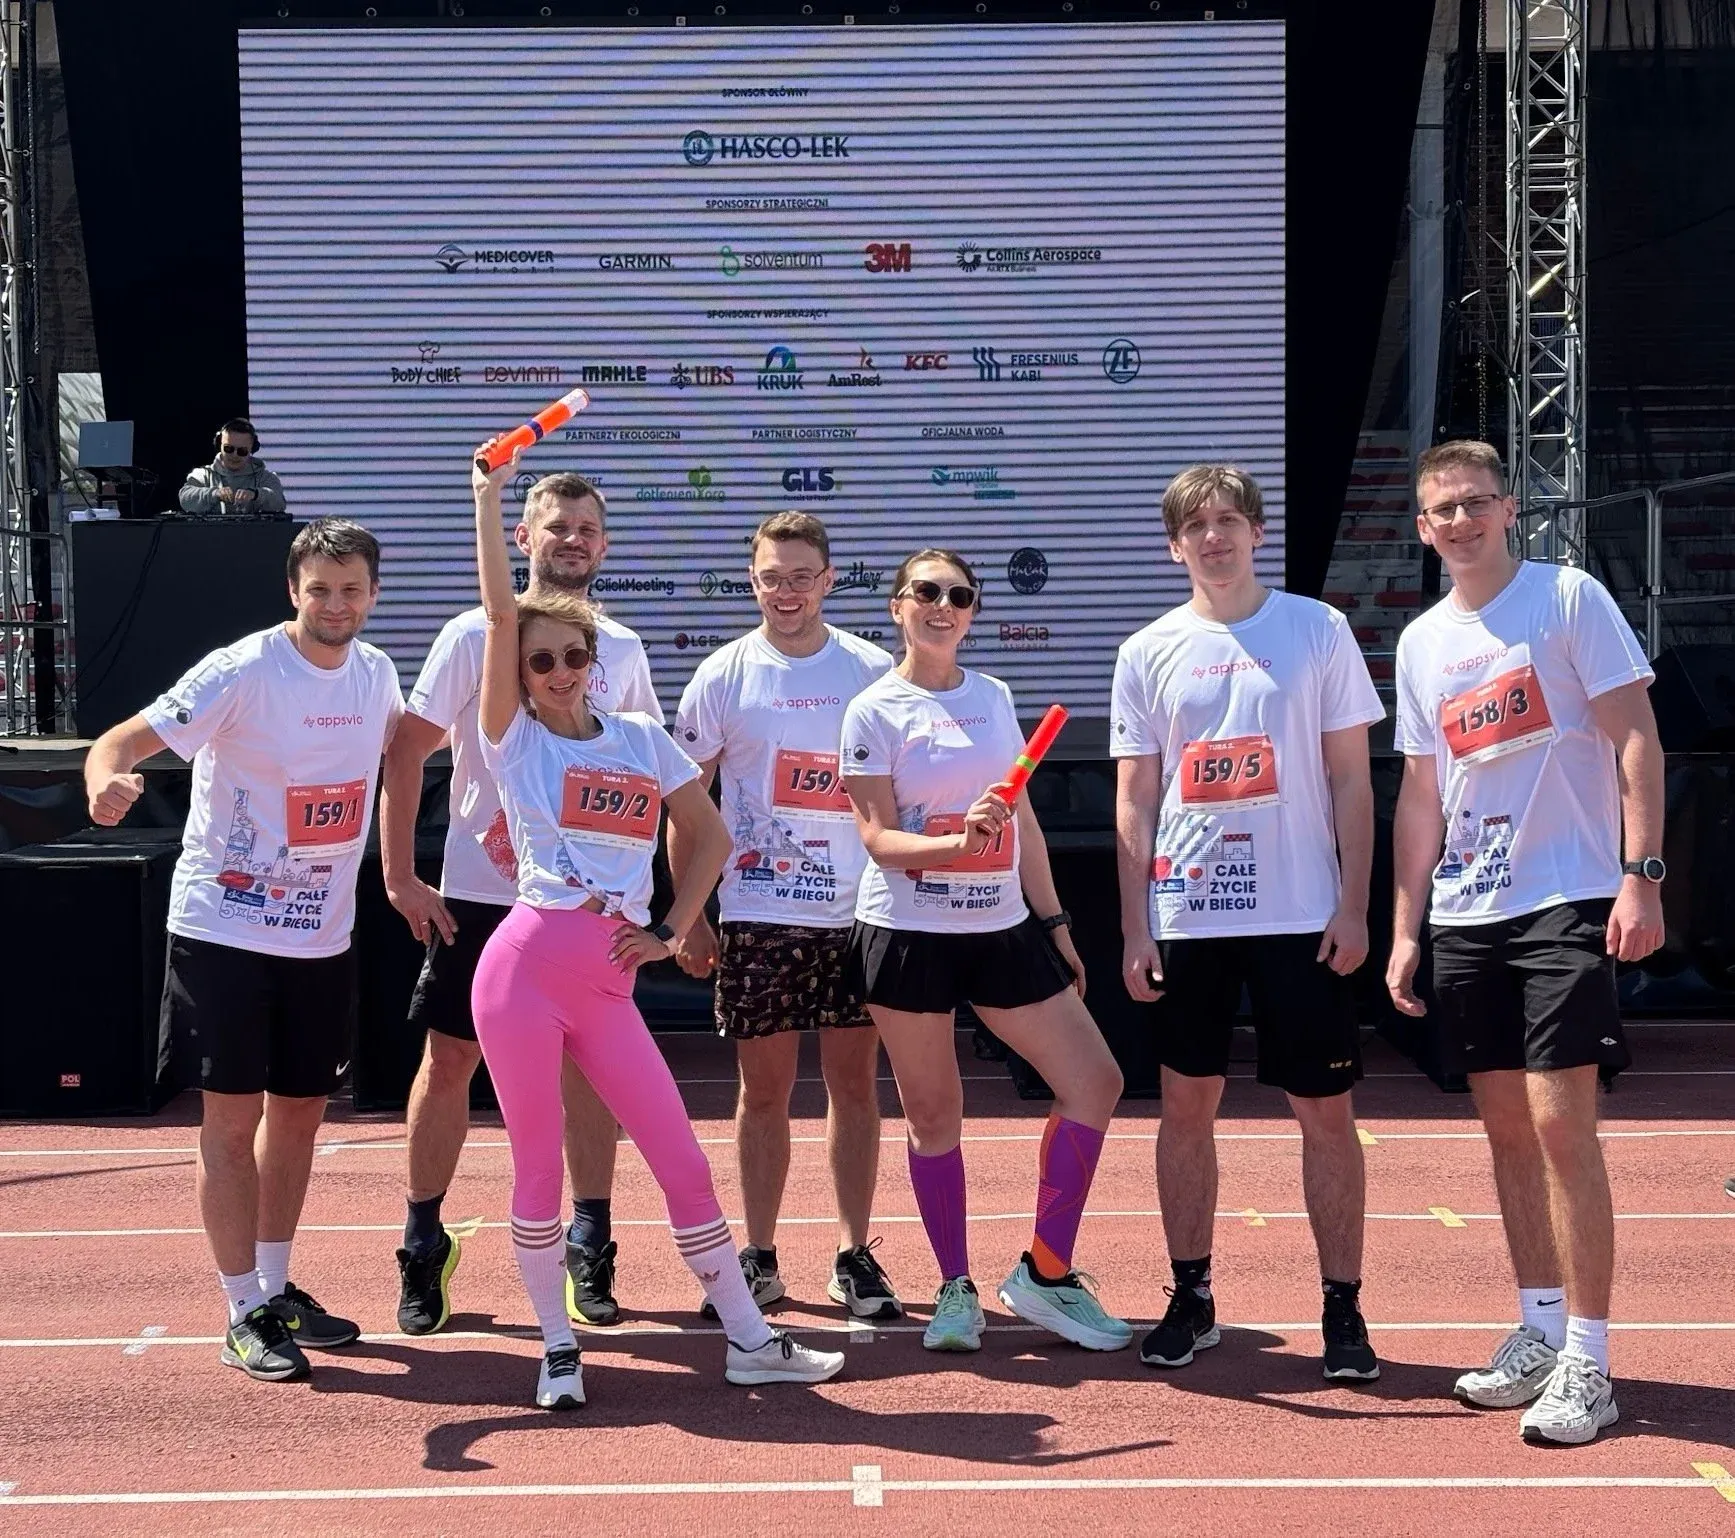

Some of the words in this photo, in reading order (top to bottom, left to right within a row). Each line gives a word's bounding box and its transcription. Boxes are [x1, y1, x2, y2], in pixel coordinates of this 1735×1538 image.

[721, 87, 765, 97] SPONSOR
[720, 136, 850, 159] HASCO-LEK
[705, 199, 761, 209] SPONSORZY
[763, 199, 828, 209] STRATEGICZNI
[474, 250, 555, 263] MEDICOVER
[744, 251, 823, 269] solventum
[864, 243, 912, 272] 3M
[986, 247, 1030, 262] Collins
[1033, 246, 1102, 263] Aerospace
[706, 309, 761, 319] SPONSORZY
[763, 308, 829, 320] WSPIERAJĄCY
[904, 354, 949, 370] KFC
[1011, 353, 1079, 367] FRESENIUS
[582, 365, 647, 382] MAHLE
[695, 365, 734, 385] UBS
[828, 373, 882, 387] AmRest
[1011, 369, 1041, 382] KABI
[757, 374, 804, 390] KRUK
[565, 431, 618, 441] PARTNERZY
[620, 430, 681, 440] EKOLOGICZNI
[752, 429, 793, 438] PARTNER
[794, 428, 857, 438] LOGISTYCZNY
[921, 427, 974, 437] OFICJALNA
[975, 426, 1004, 436] WODA
[595, 577, 675, 596] ClickMeeting
[720, 579, 752, 594] Gree
[999, 622, 1049, 641] Balcia
[691, 635, 707, 647] LG
[1457, 647, 1508, 671] appsvio
[1209, 657, 1272, 678] appsvio
[786, 696, 841, 710] appsvio
[1459, 688, 1529, 736] 158/3
[317, 713, 363, 728] appsvio
[942, 715, 987, 729] appsvio
[1193, 752, 1263, 785] 159/5
[580, 786, 650, 820] 159/2
[304, 798, 359, 829] 159/1
[801, 861, 835, 875] CAŁE
[1215, 863, 1257, 877] CAŁE
[795, 872, 836, 888] ŻYCIE
[1210, 879, 1257, 894] ŻYCIE
[775, 888, 790, 898] W
[792, 889, 835, 902] BIEGU
[1461, 884, 1471, 896] W
[951, 900, 964, 909] W
[966, 896, 1000, 909] BIEGU
[1188, 899, 1205, 912] W
[1209, 897, 1257, 911] BIEGU
[264, 915, 280, 927] W
[282, 917, 321, 930] BIEGU
